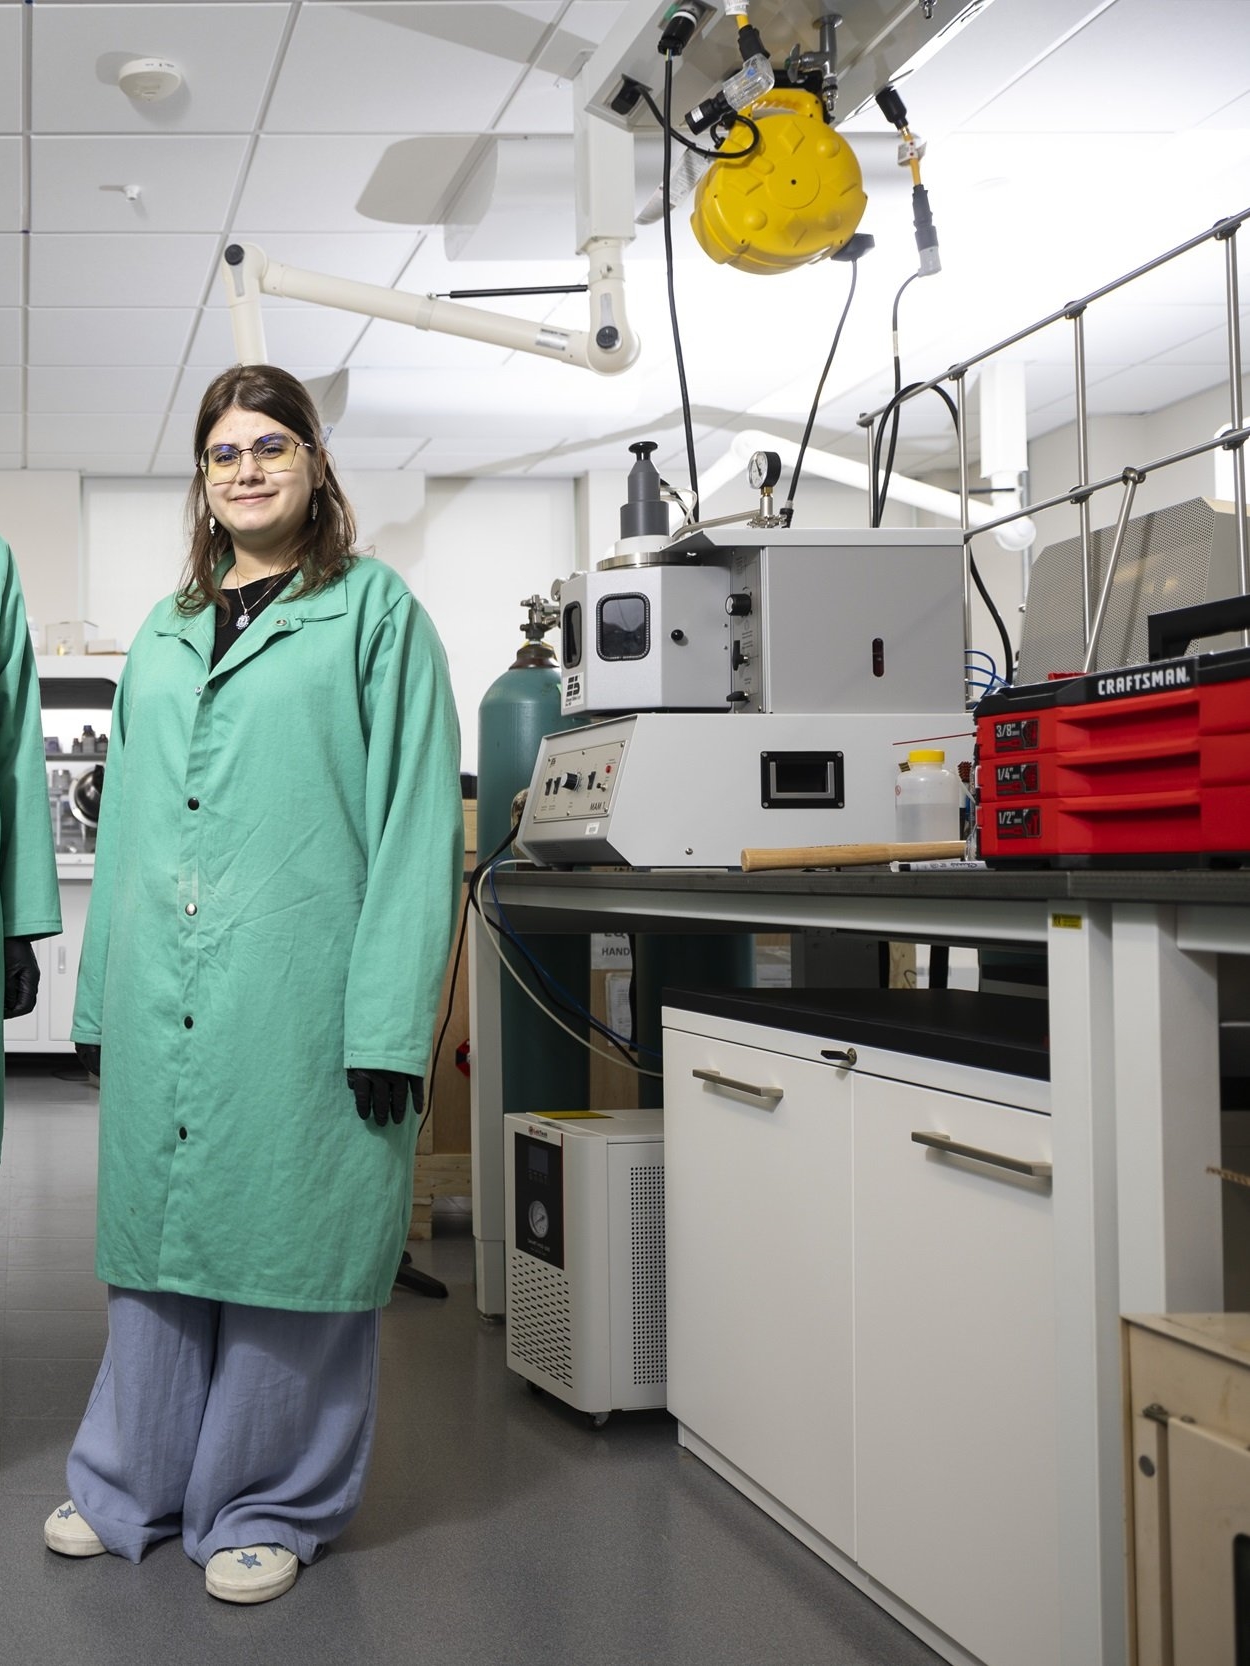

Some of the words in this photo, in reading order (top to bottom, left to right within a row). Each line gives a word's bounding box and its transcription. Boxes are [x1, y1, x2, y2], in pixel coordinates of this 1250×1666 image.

[1097, 666, 1187, 696] CRAFTSMAN
[996, 723, 1016, 738] 3/8"
[997, 767, 1014, 781] 1/4"
[999, 810, 1016, 825] 1/2"
